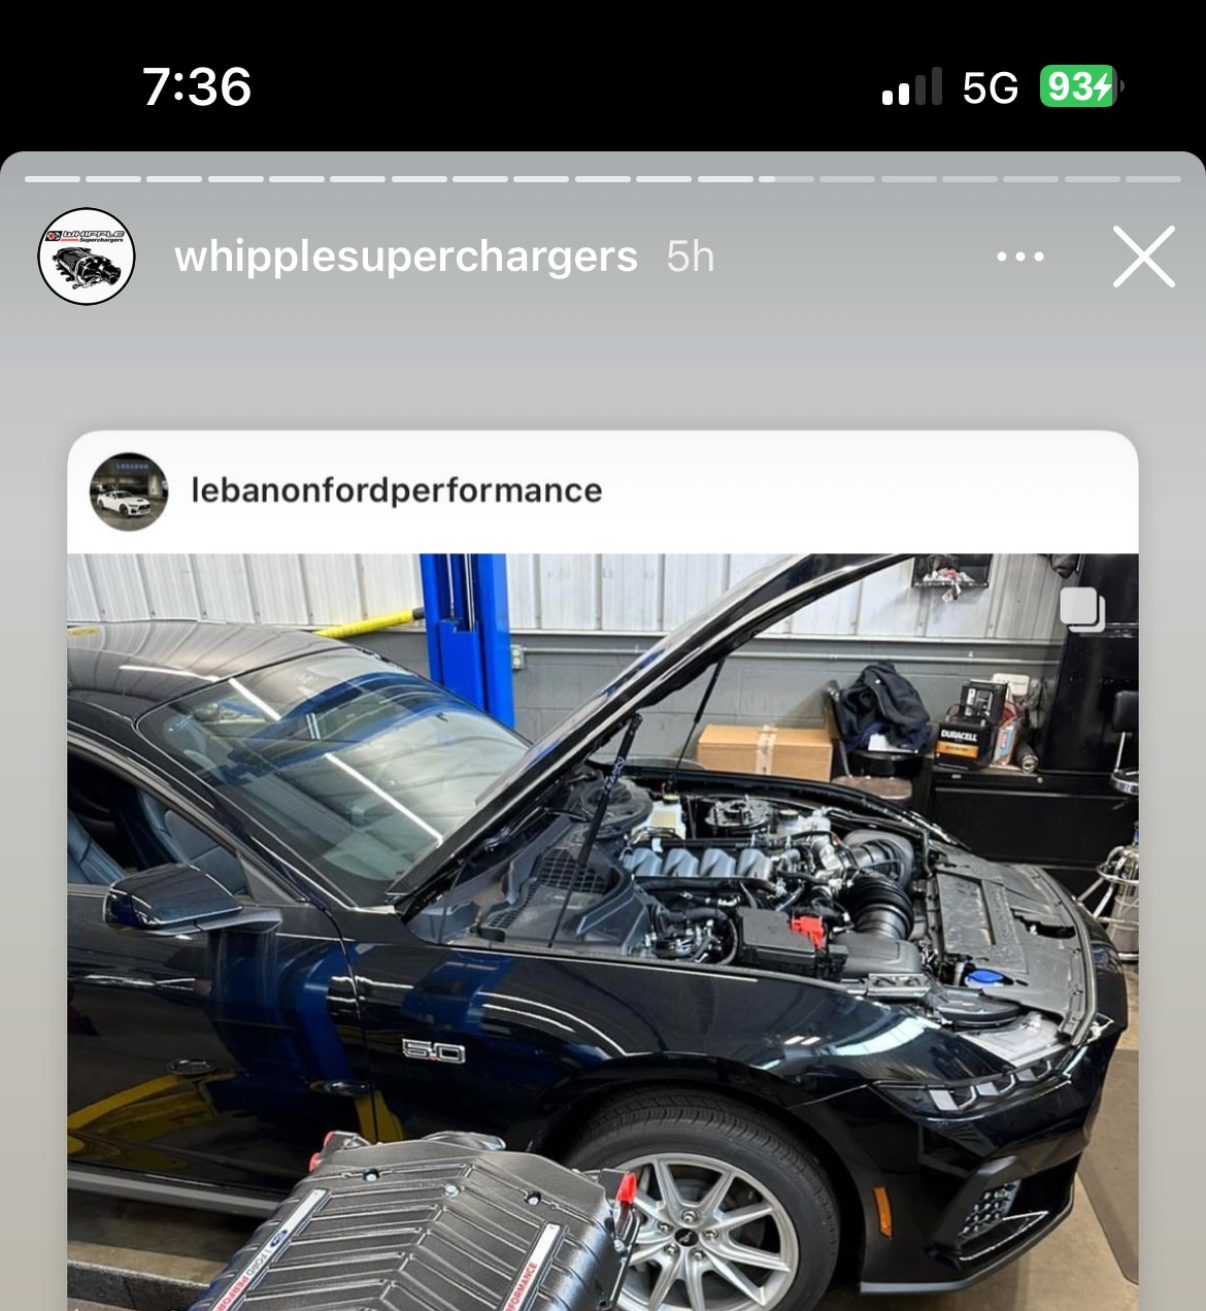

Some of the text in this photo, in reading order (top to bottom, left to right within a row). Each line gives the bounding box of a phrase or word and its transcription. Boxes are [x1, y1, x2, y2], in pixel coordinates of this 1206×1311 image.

[941, 729, 978, 742] DURACELL
[402, 1038, 466, 1064] 5.0
[246, 1249, 268, 1276] FORD
